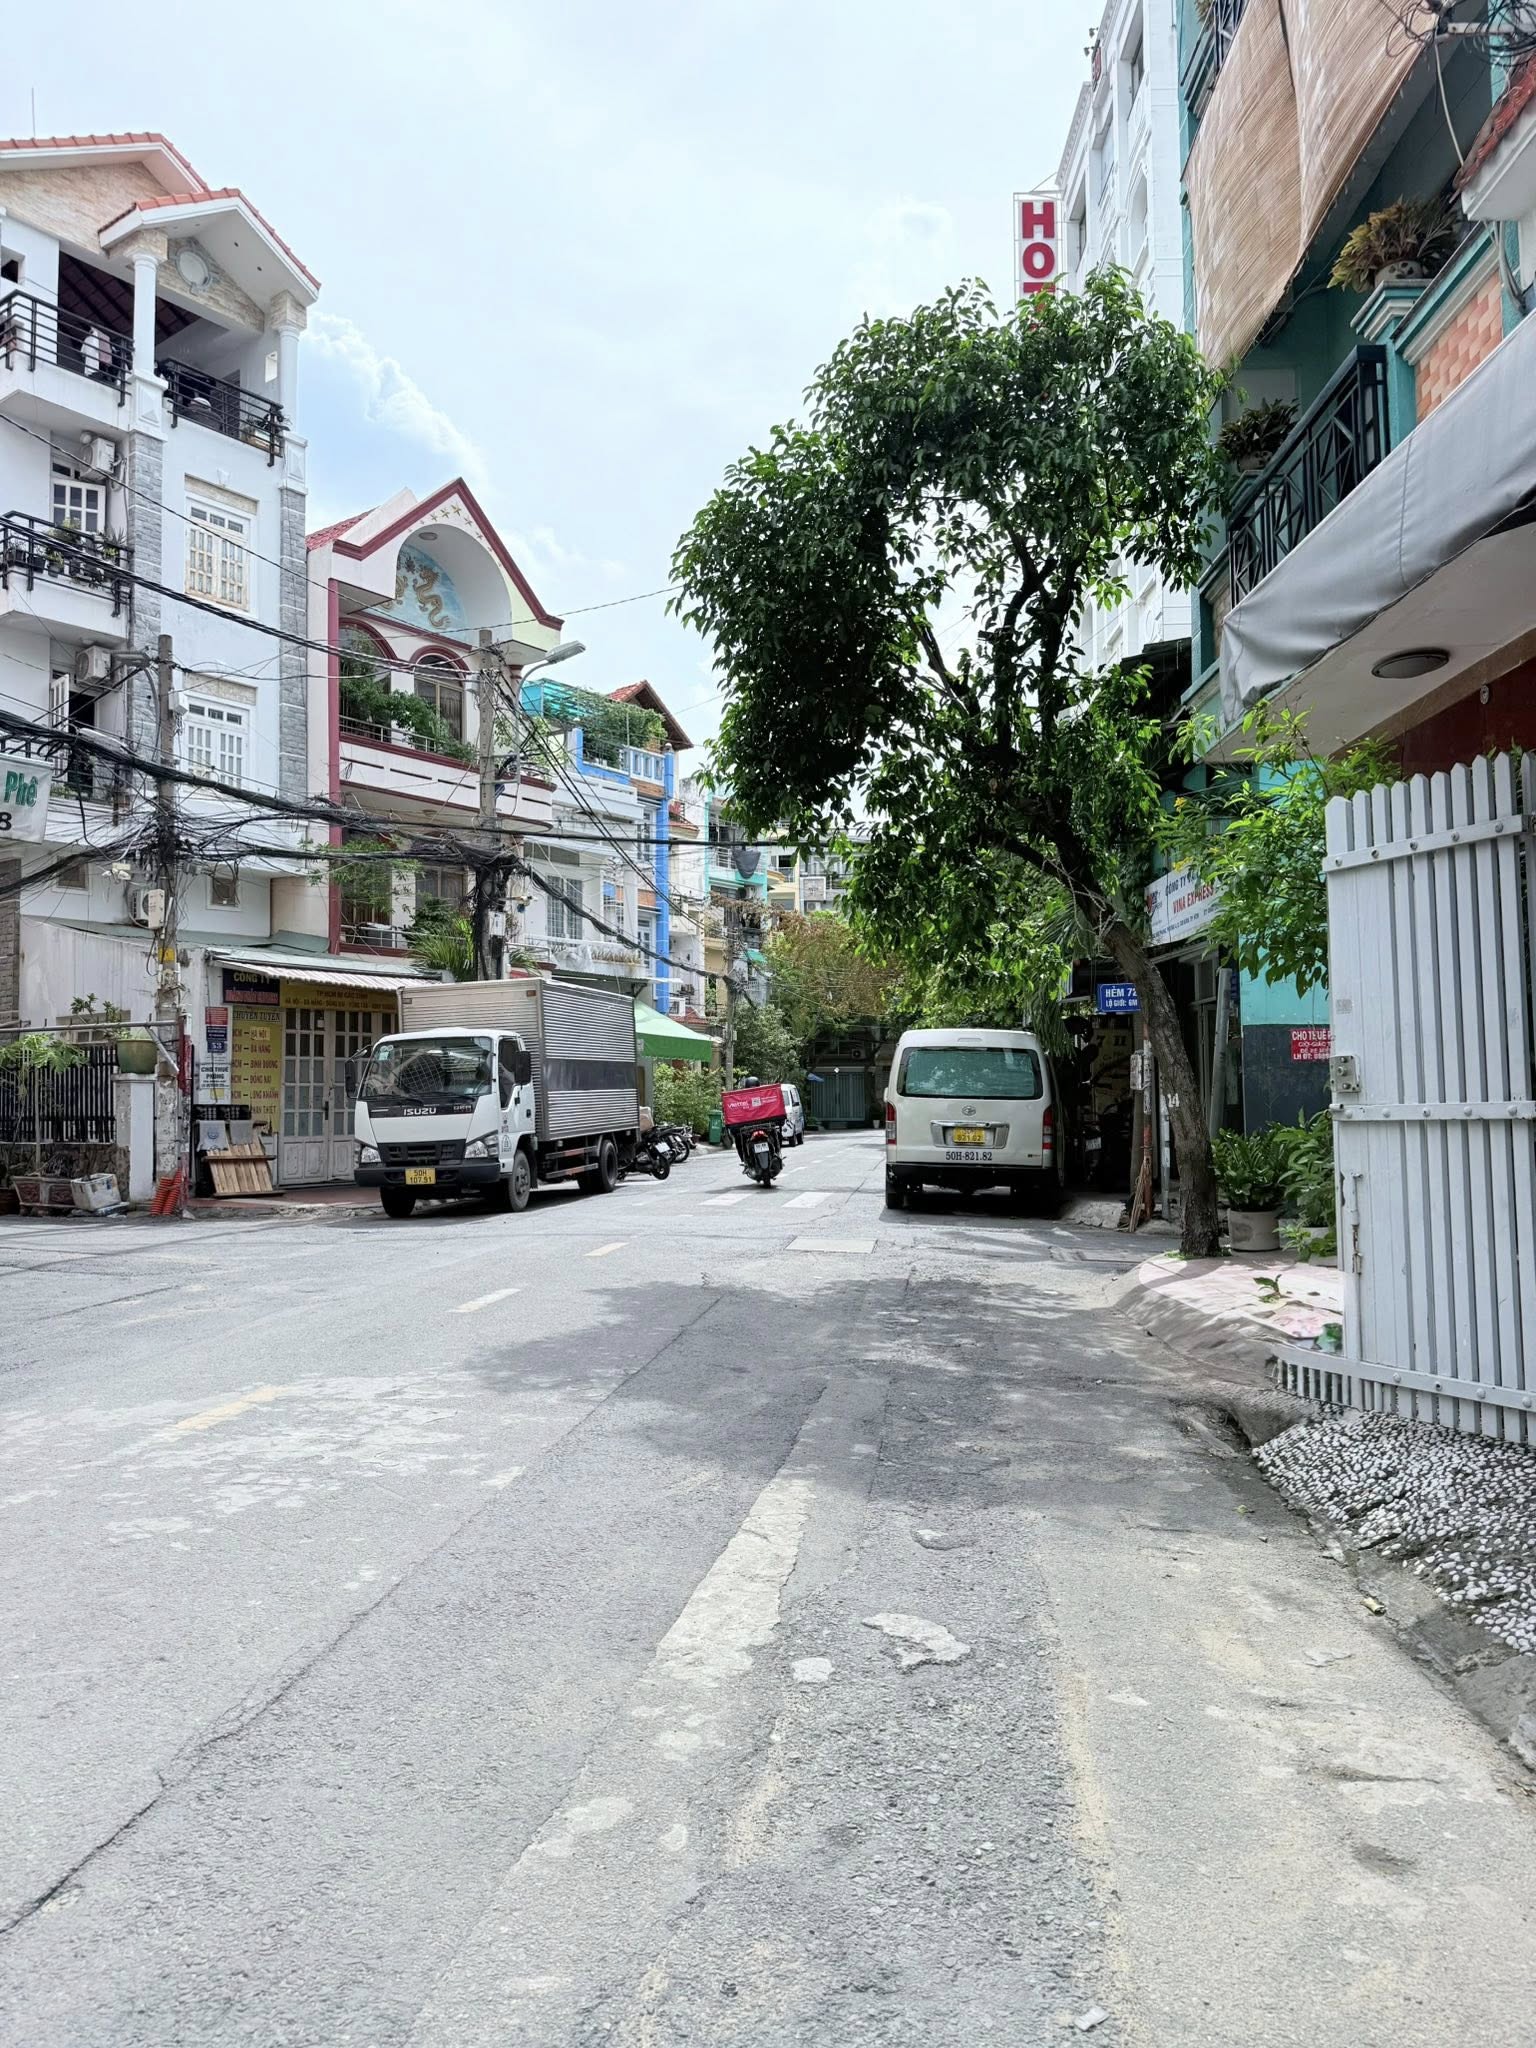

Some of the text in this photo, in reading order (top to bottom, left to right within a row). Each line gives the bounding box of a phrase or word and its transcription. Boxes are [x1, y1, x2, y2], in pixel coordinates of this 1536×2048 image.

[4, 769, 39, 807] Phê
[1173, 896, 1186, 914] VINA
[1187, 883, 1214, 907] EXPRESS
[1105, 985, 1124, 998] HẺM
[1292, 1030, 1307, 1041] CHO
[403, 1107, 437, 1116] ISUZU
[945, 1151, 992, 1161] 50H-821.82
[414, 1169, 427, 1177] 50H
[410, 1176, 432, 1184] 107.91
